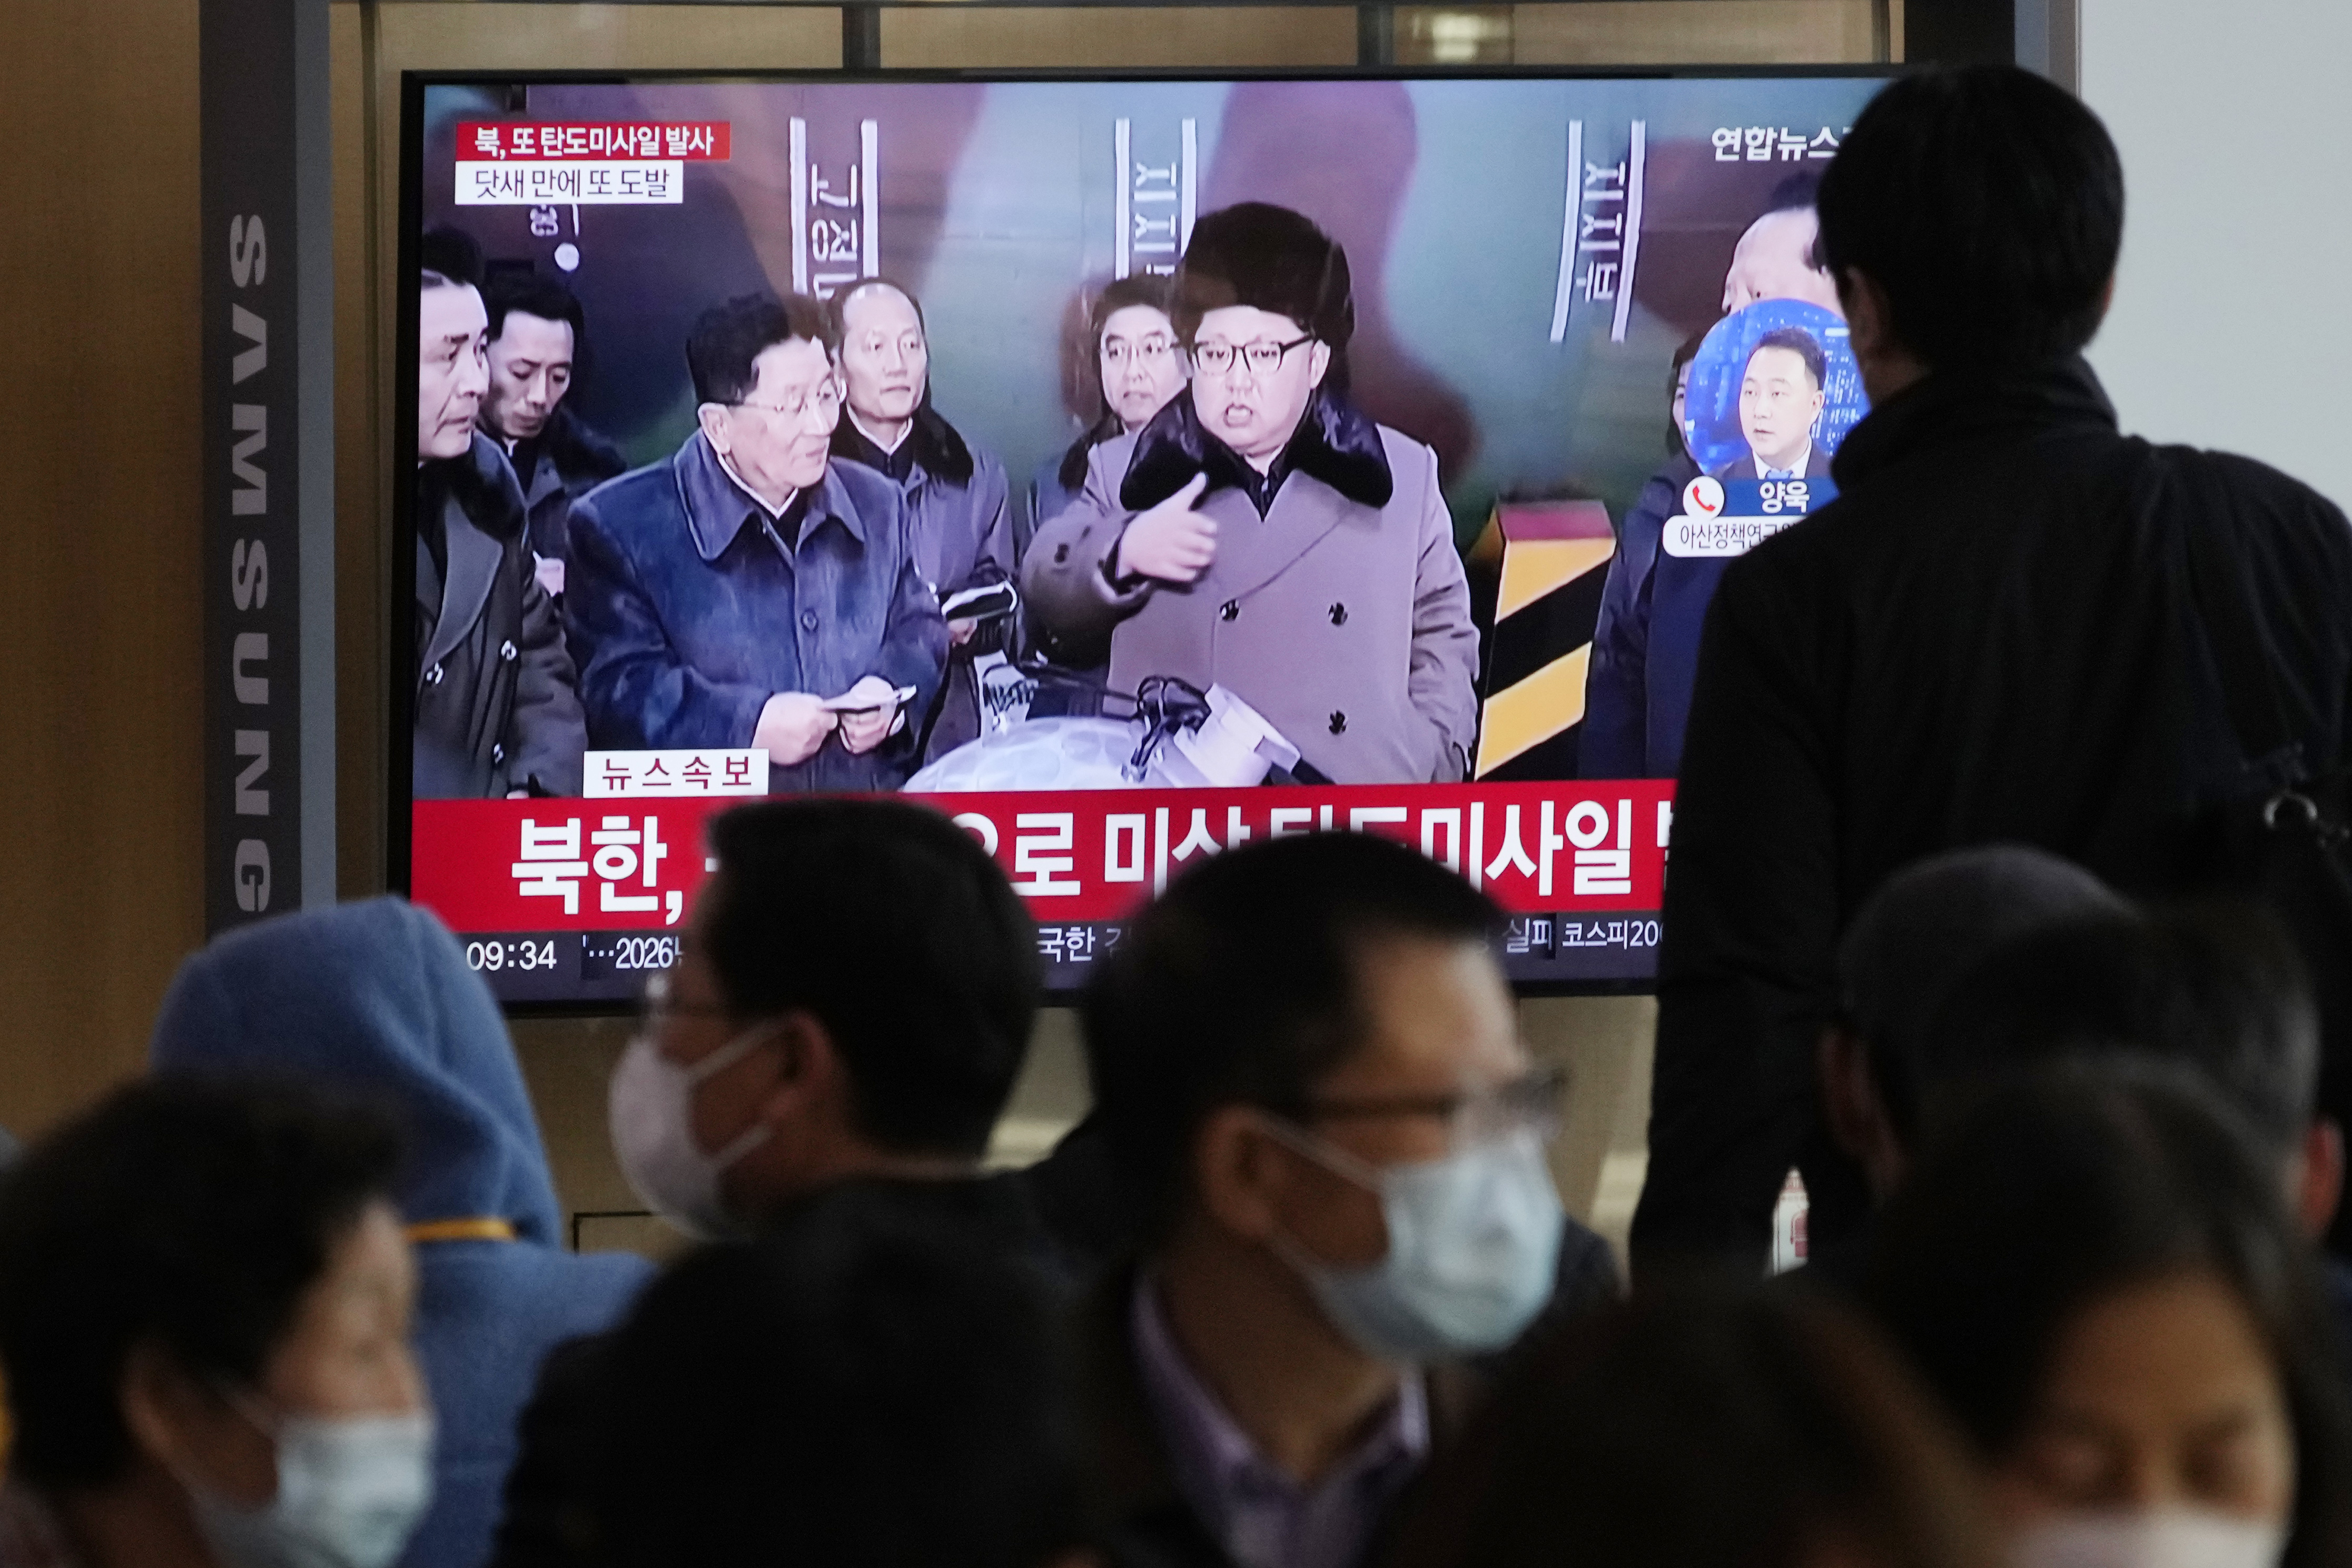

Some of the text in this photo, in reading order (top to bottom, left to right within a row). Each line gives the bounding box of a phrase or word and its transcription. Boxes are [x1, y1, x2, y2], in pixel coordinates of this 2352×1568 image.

[475, 125, 714, 160] 북, 또 탄도미사일 발사
[1711, 125, 1851, 162] 연합뉴스
[475, 168, 670, 199] 닷새 만에 또 도발
[1760, 481, 1810, 514] 양욱
[230, 213, 271, 913] SAMSUNG
[511, 815, 683, 925] 북한,
[1562, 919, 1663, 950] 코스피20
[466, 939, 557, 971] 09:34
